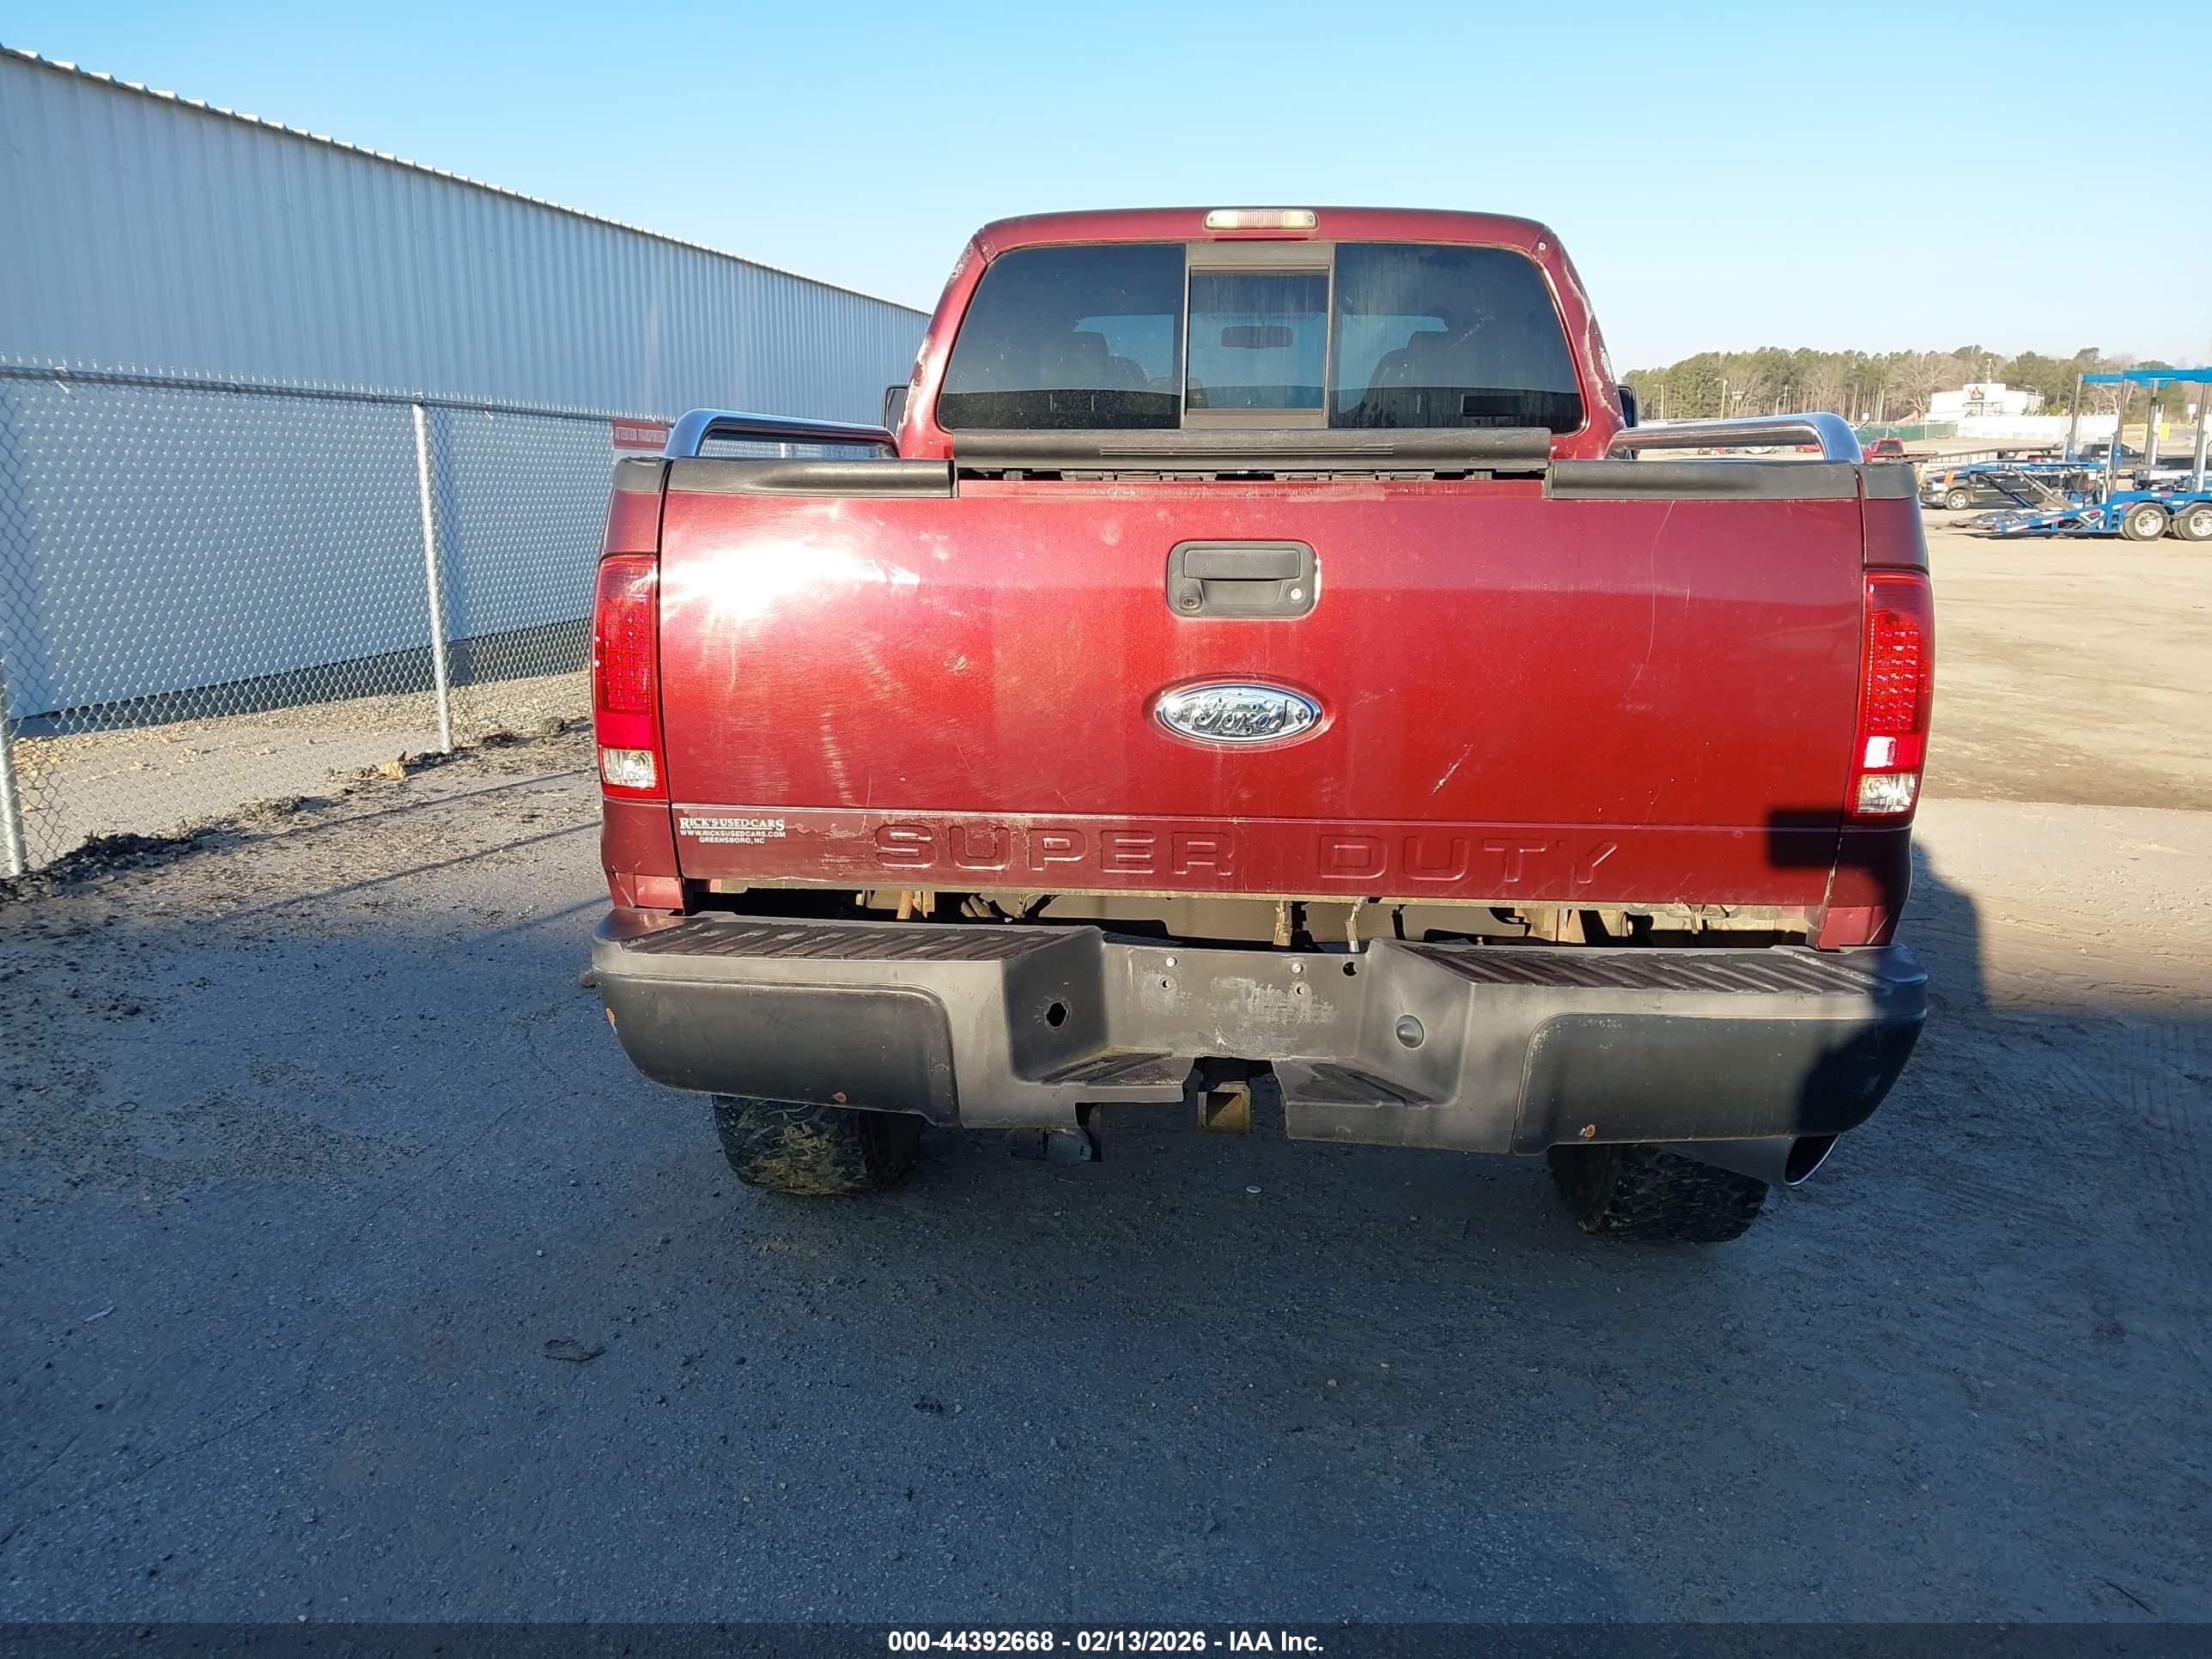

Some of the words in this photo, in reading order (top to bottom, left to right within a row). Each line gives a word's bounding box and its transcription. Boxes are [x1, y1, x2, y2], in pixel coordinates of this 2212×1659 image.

[678, 817, 719, 830] RICK'S
[720, 817, 748, 828] USED
[750, 818, 785, 831] CARS
[679, 830, 786, 838] WWW.RICKSUSEDCARS.COM
[874, 823, 1235, 877] SUPER
[1318, 835, 1618, 885] DUTY
